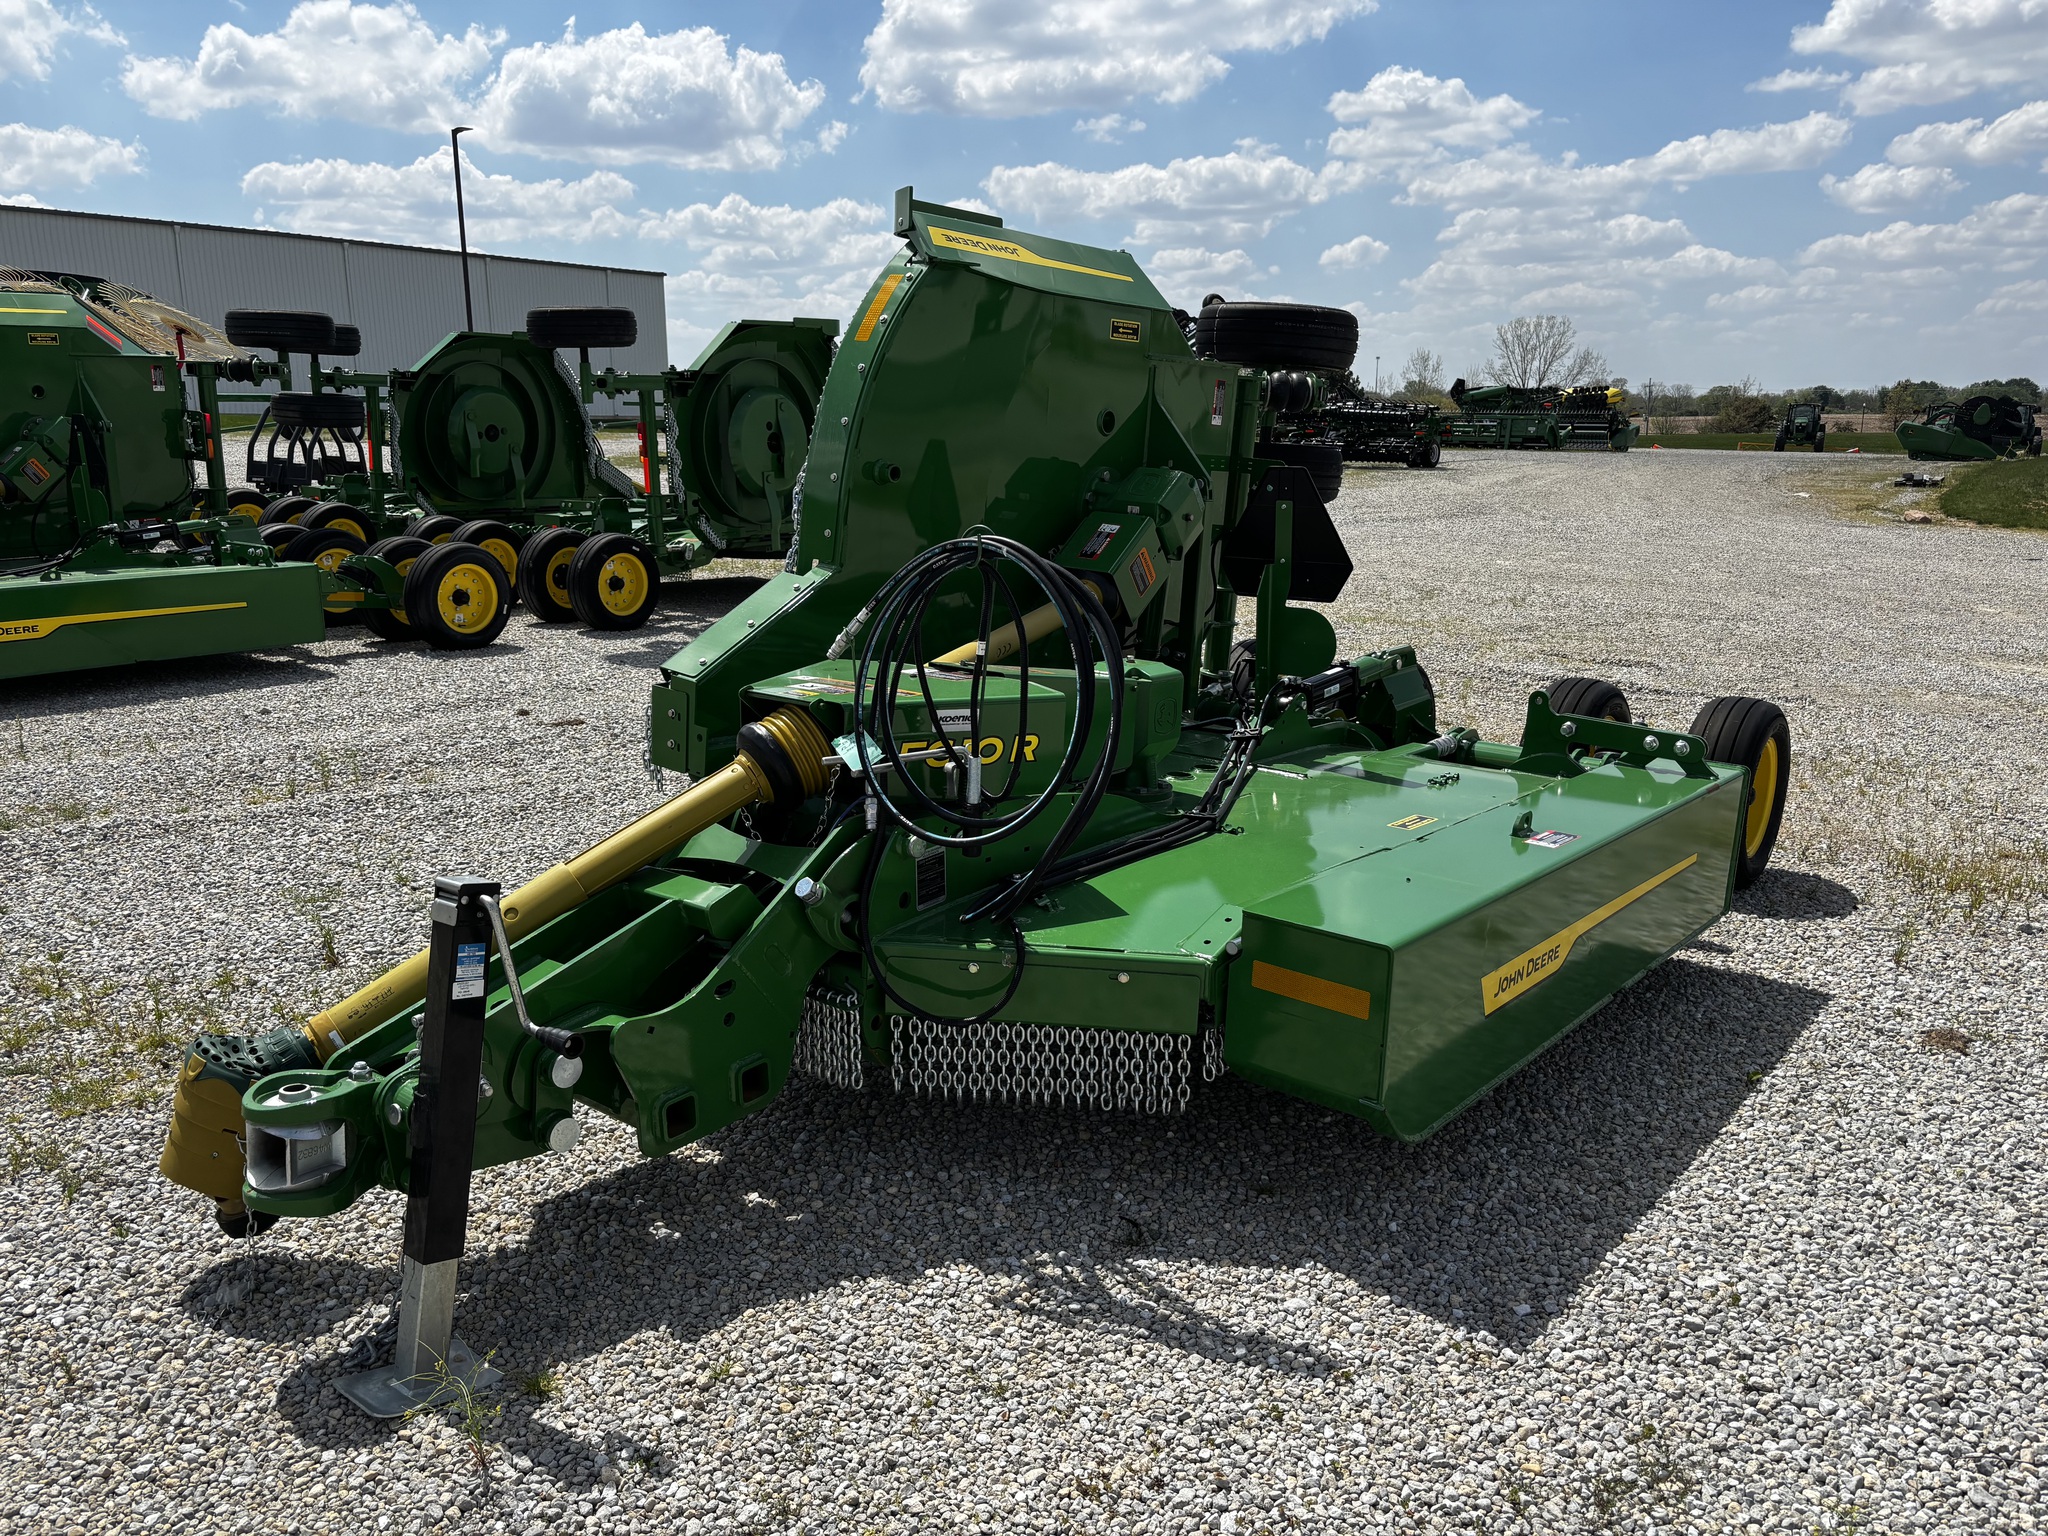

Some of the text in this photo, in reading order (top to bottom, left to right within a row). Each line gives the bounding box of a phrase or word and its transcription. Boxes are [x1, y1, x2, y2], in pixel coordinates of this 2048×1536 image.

[941, 233, 1020, 257] JOHN DEERE
[1493, 943, 1561, 998] JOHN DEERE
